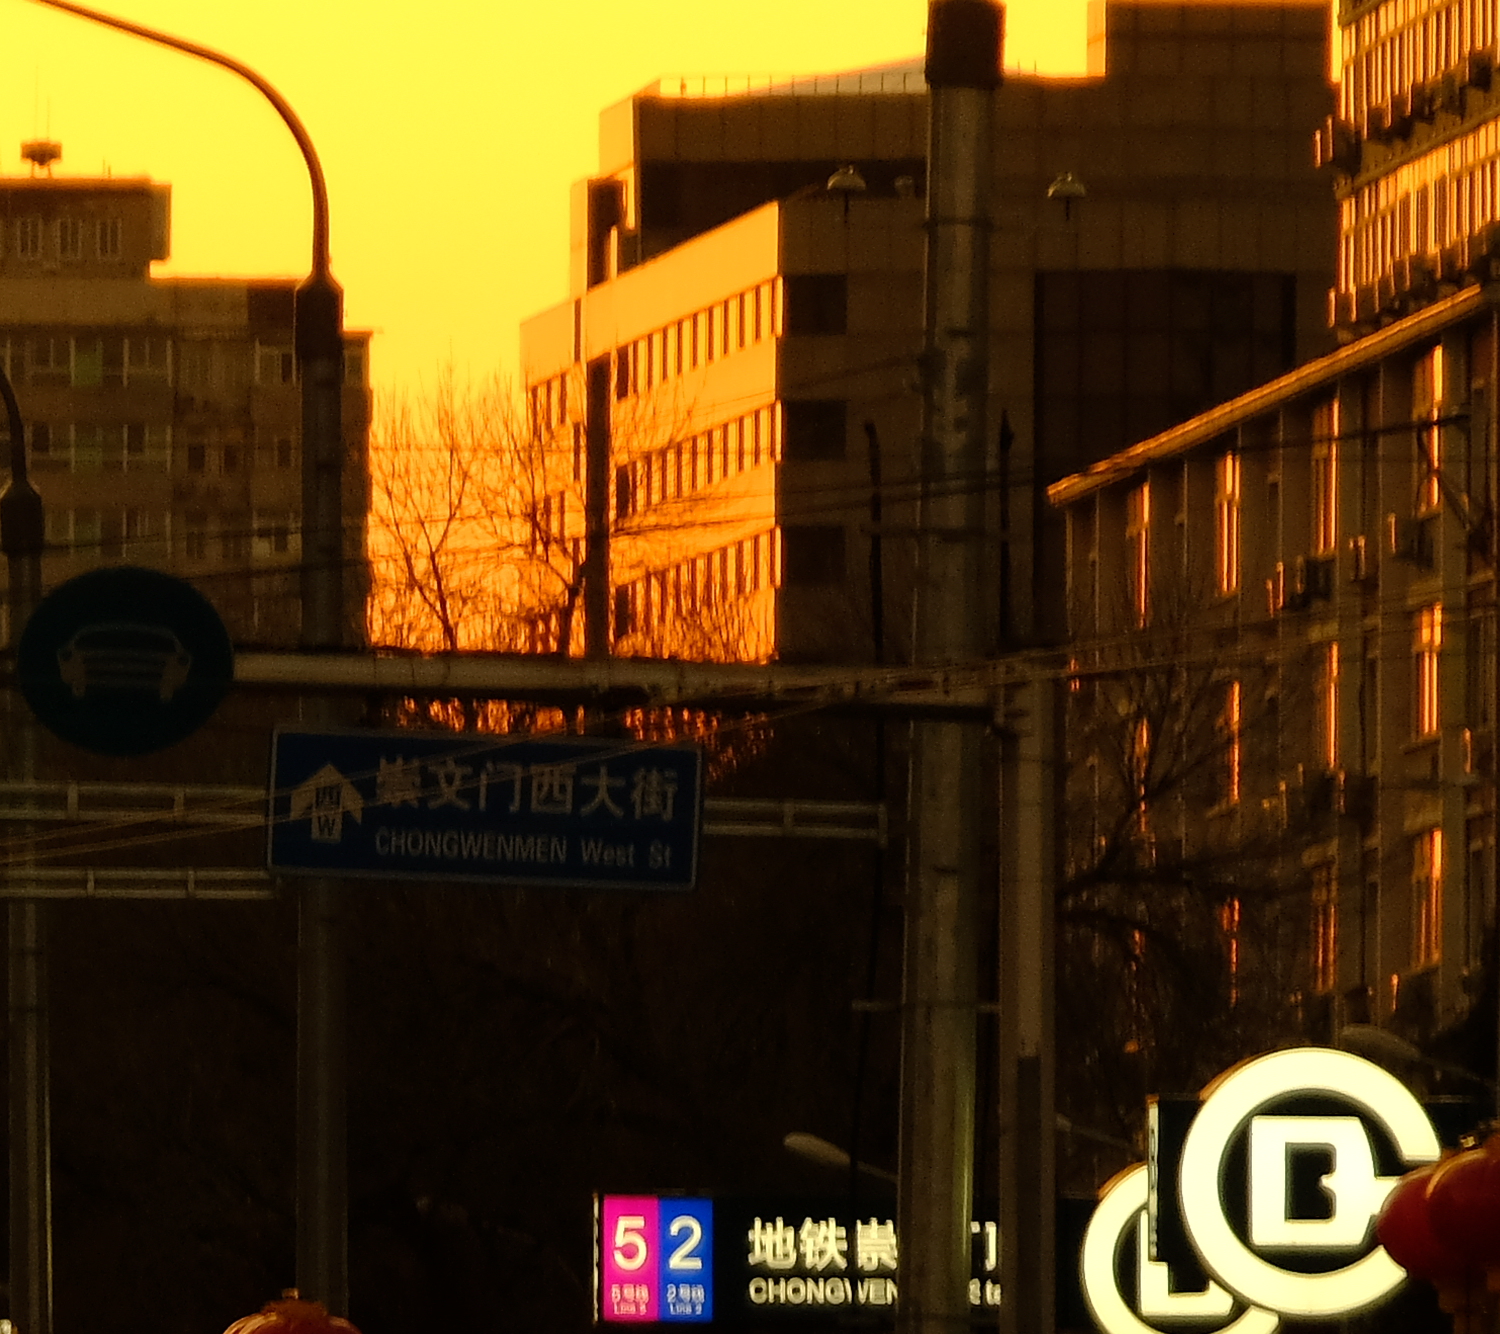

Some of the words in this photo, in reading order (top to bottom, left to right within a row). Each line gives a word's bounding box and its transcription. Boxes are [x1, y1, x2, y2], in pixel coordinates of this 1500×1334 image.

[375, 754, 679, 823] 崇文门西大街
[375, 825, 568, 865] CHONGWENMEN
[580, 837, 636, 868] West
[648, 838, 673, 869] St
[613, 1215, 648, 1271] 5
[669, 1214, 703, 1270] 2
[747, 1216, 997, 1272] 地铁崇
